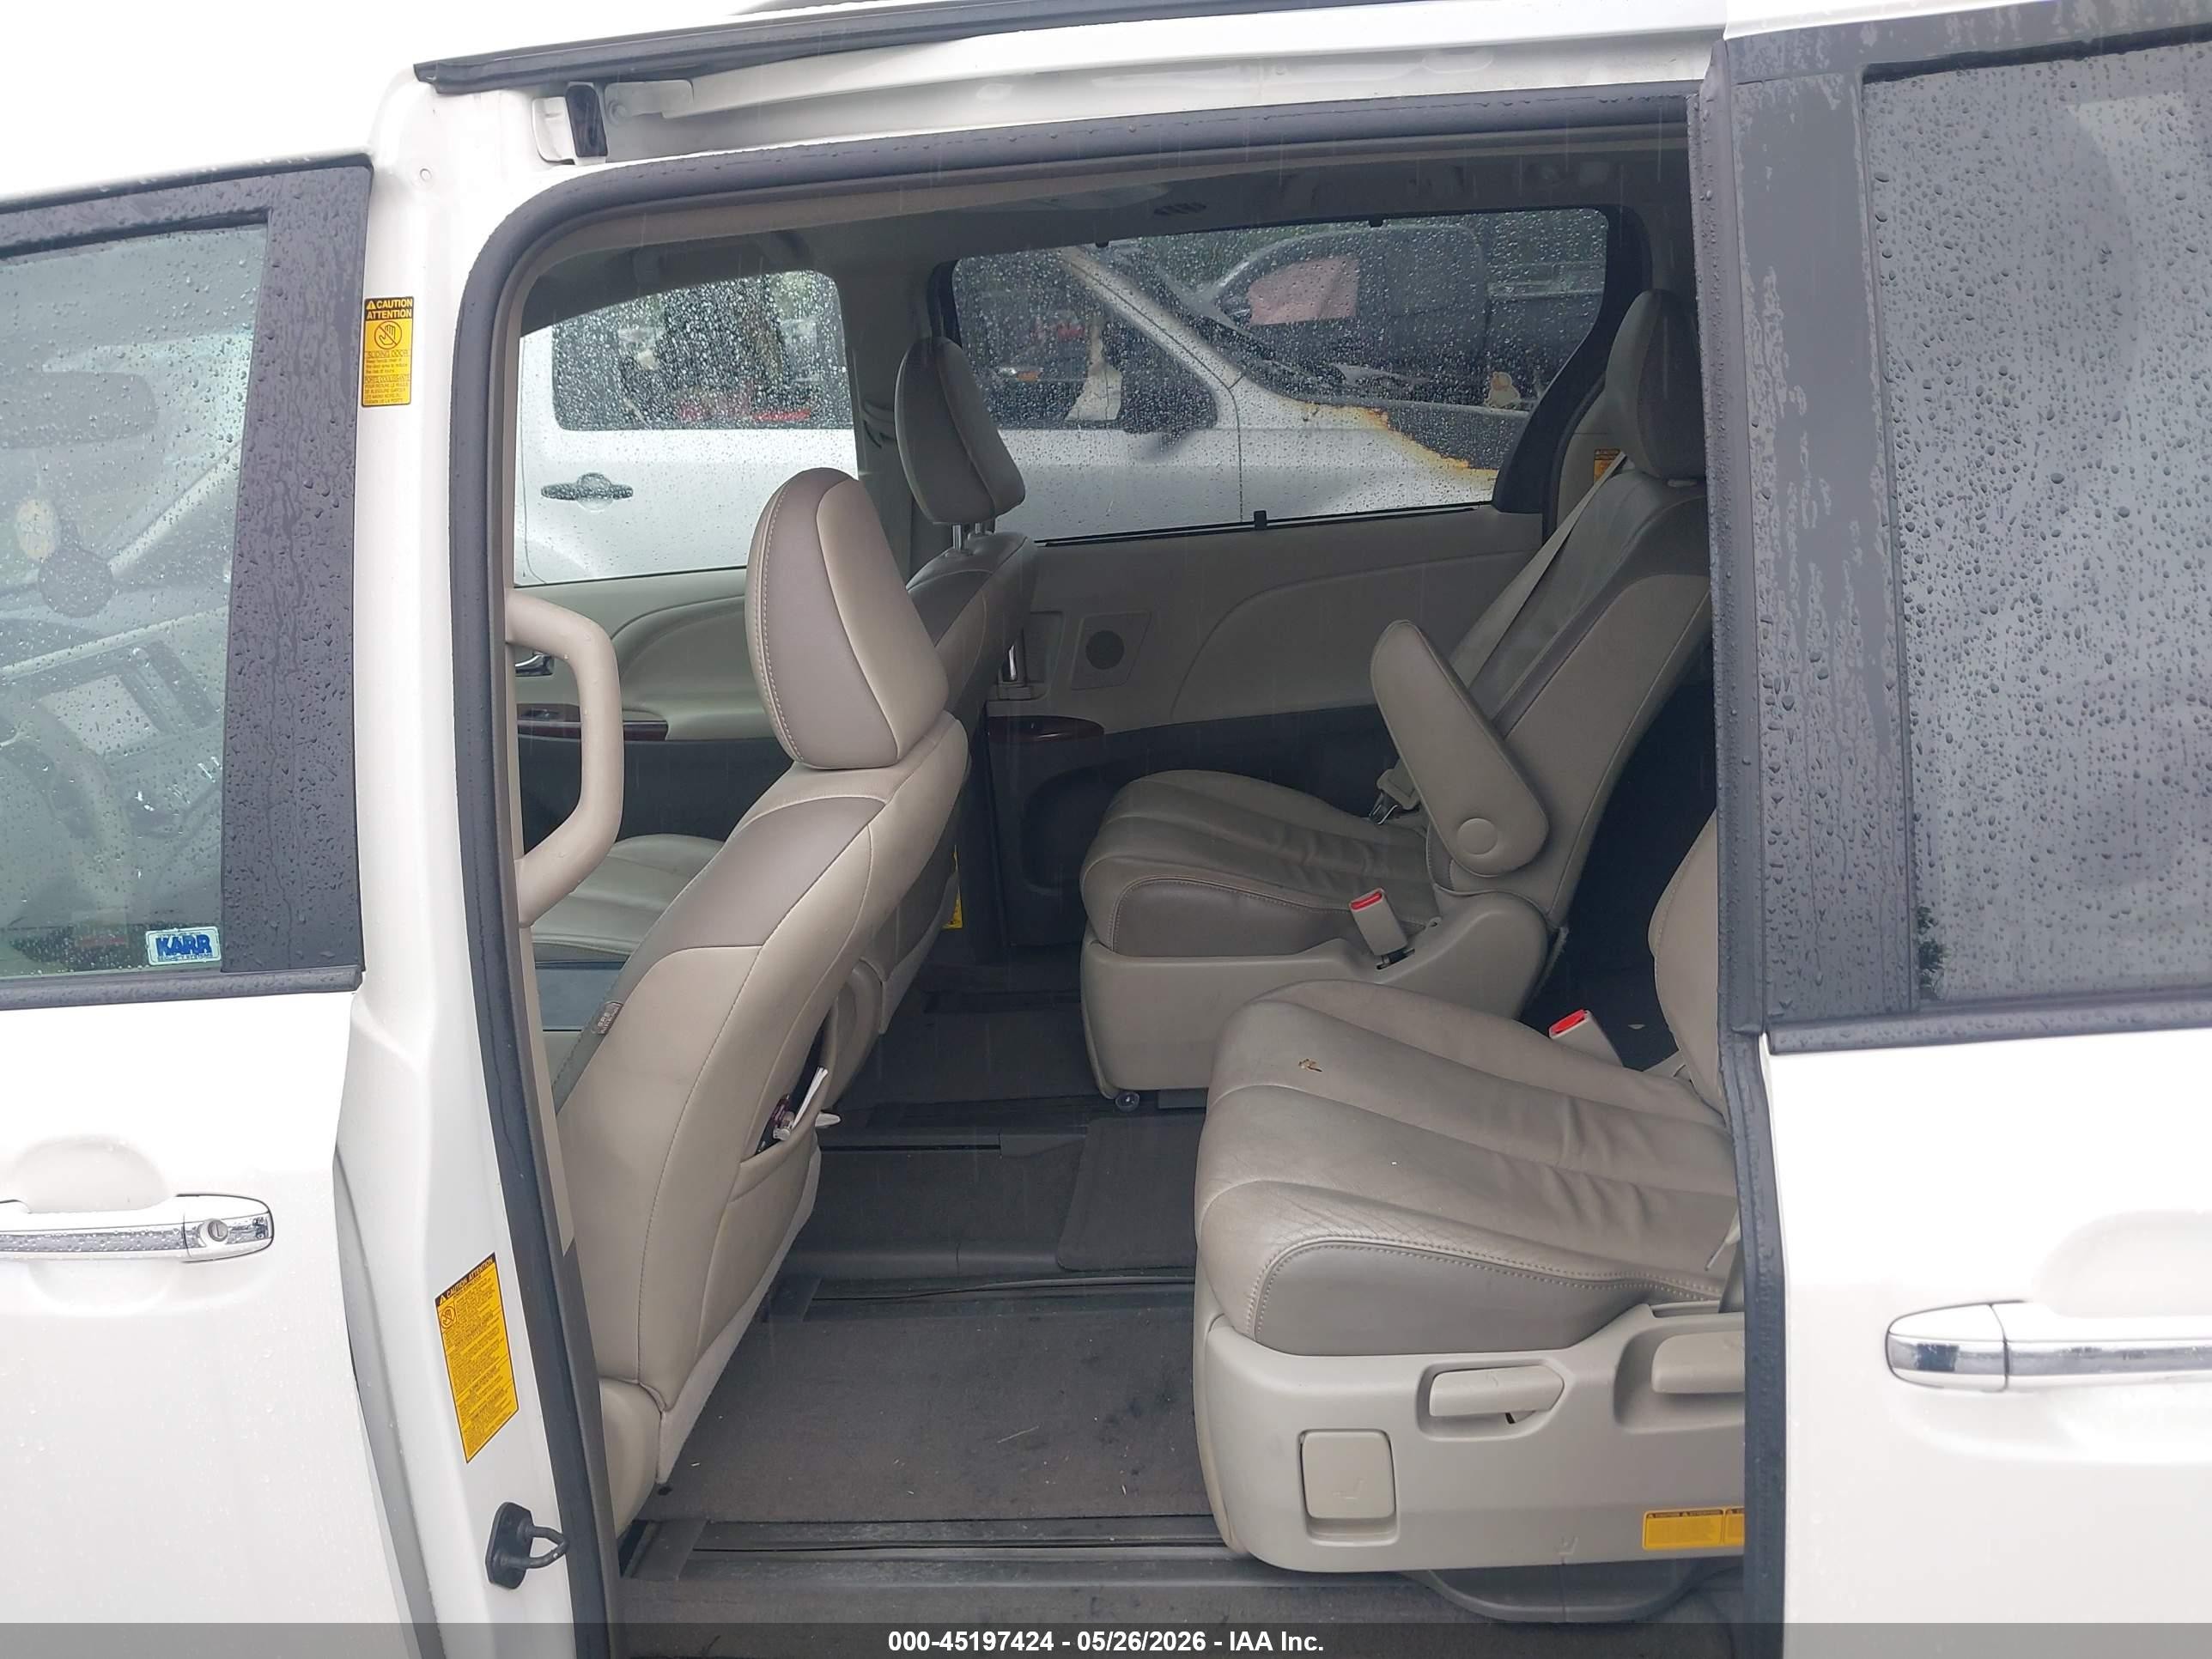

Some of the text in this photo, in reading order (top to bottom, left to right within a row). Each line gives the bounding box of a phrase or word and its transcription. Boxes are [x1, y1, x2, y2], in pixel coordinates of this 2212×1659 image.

[376, 299, 413, 309] CAUTION
[367, 308, 412, 319] ATTENTION
[155, 934, 212, 957] KARR
[447, 1277, 468, 1297] CAUTION
[468, 1257, 494, 1281] ATTENTION
